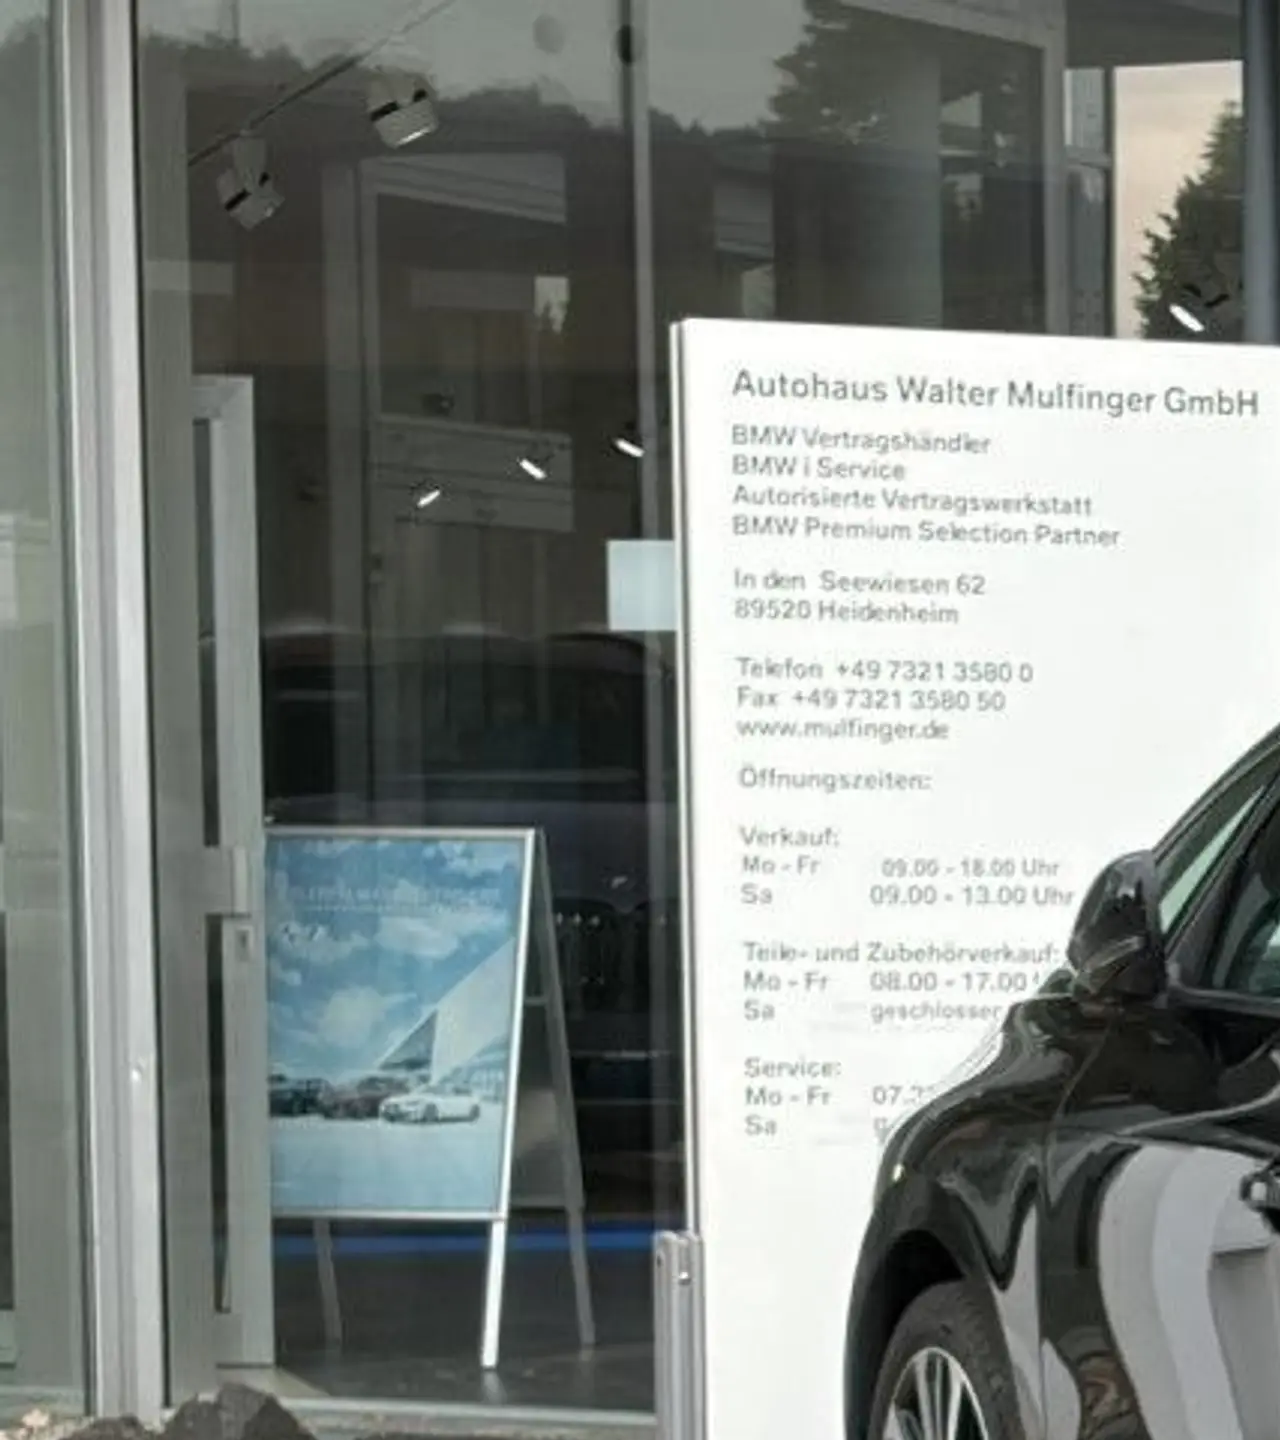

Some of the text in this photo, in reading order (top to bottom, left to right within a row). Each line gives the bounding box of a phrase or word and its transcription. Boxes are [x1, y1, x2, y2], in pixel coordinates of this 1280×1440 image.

[732, 369, 1260, 418] Autohaus Walter Mulfinger GmbH
[732, 424, 991, 456] BMW Vertragshändler
[732, 454, 906, 481] BMW i Service
[732, 484, 1092, 517] Autorisierte Vertragswerkstatt
[732, 514, 1120, 547] BMW Premium Selection Partner
[734, 568, 985, 596] In den Seewiesen 62
[734, 598, 959, 624] 89520 Heidenheim
[735, 657, 1033, 683] Telefon +49 7321 3580 0
[737, 685, 1006, 712] Fax +49 7321 3580 50
[736, 718, 949, 744] www.mulfinger.de
[739, 764, 932, 794] Öffnungszeiten:
[739, 826, 842, 848] Verkauf:
[742, 855, 776, 874] Mo
[797, 854, 821, 875] Fr
[882, 858, 940, 878] 09.00
[1021, 858, 1060, 877] Uhr
[741, 883, 773, 904] Sa
[869, 884, 937, 906] 09.00
[1032, 886, 1074, 907] Uhr
[743, 941, 1061, 965] Teile- und Zubehörverkauf:
[744, 970, 781, 991] Mo
[804, 971, 828, 991] Fr
[962, 971, 1028, 993] 17.00
[744, 999, 775, 1021] Sa
[744, 1057, 841, 1078] Service:
[745, 1086, 782, 1106] Mo
[807, 1085, 831, 1105] Fr
[745, 1114, 777, 1136] Sa
